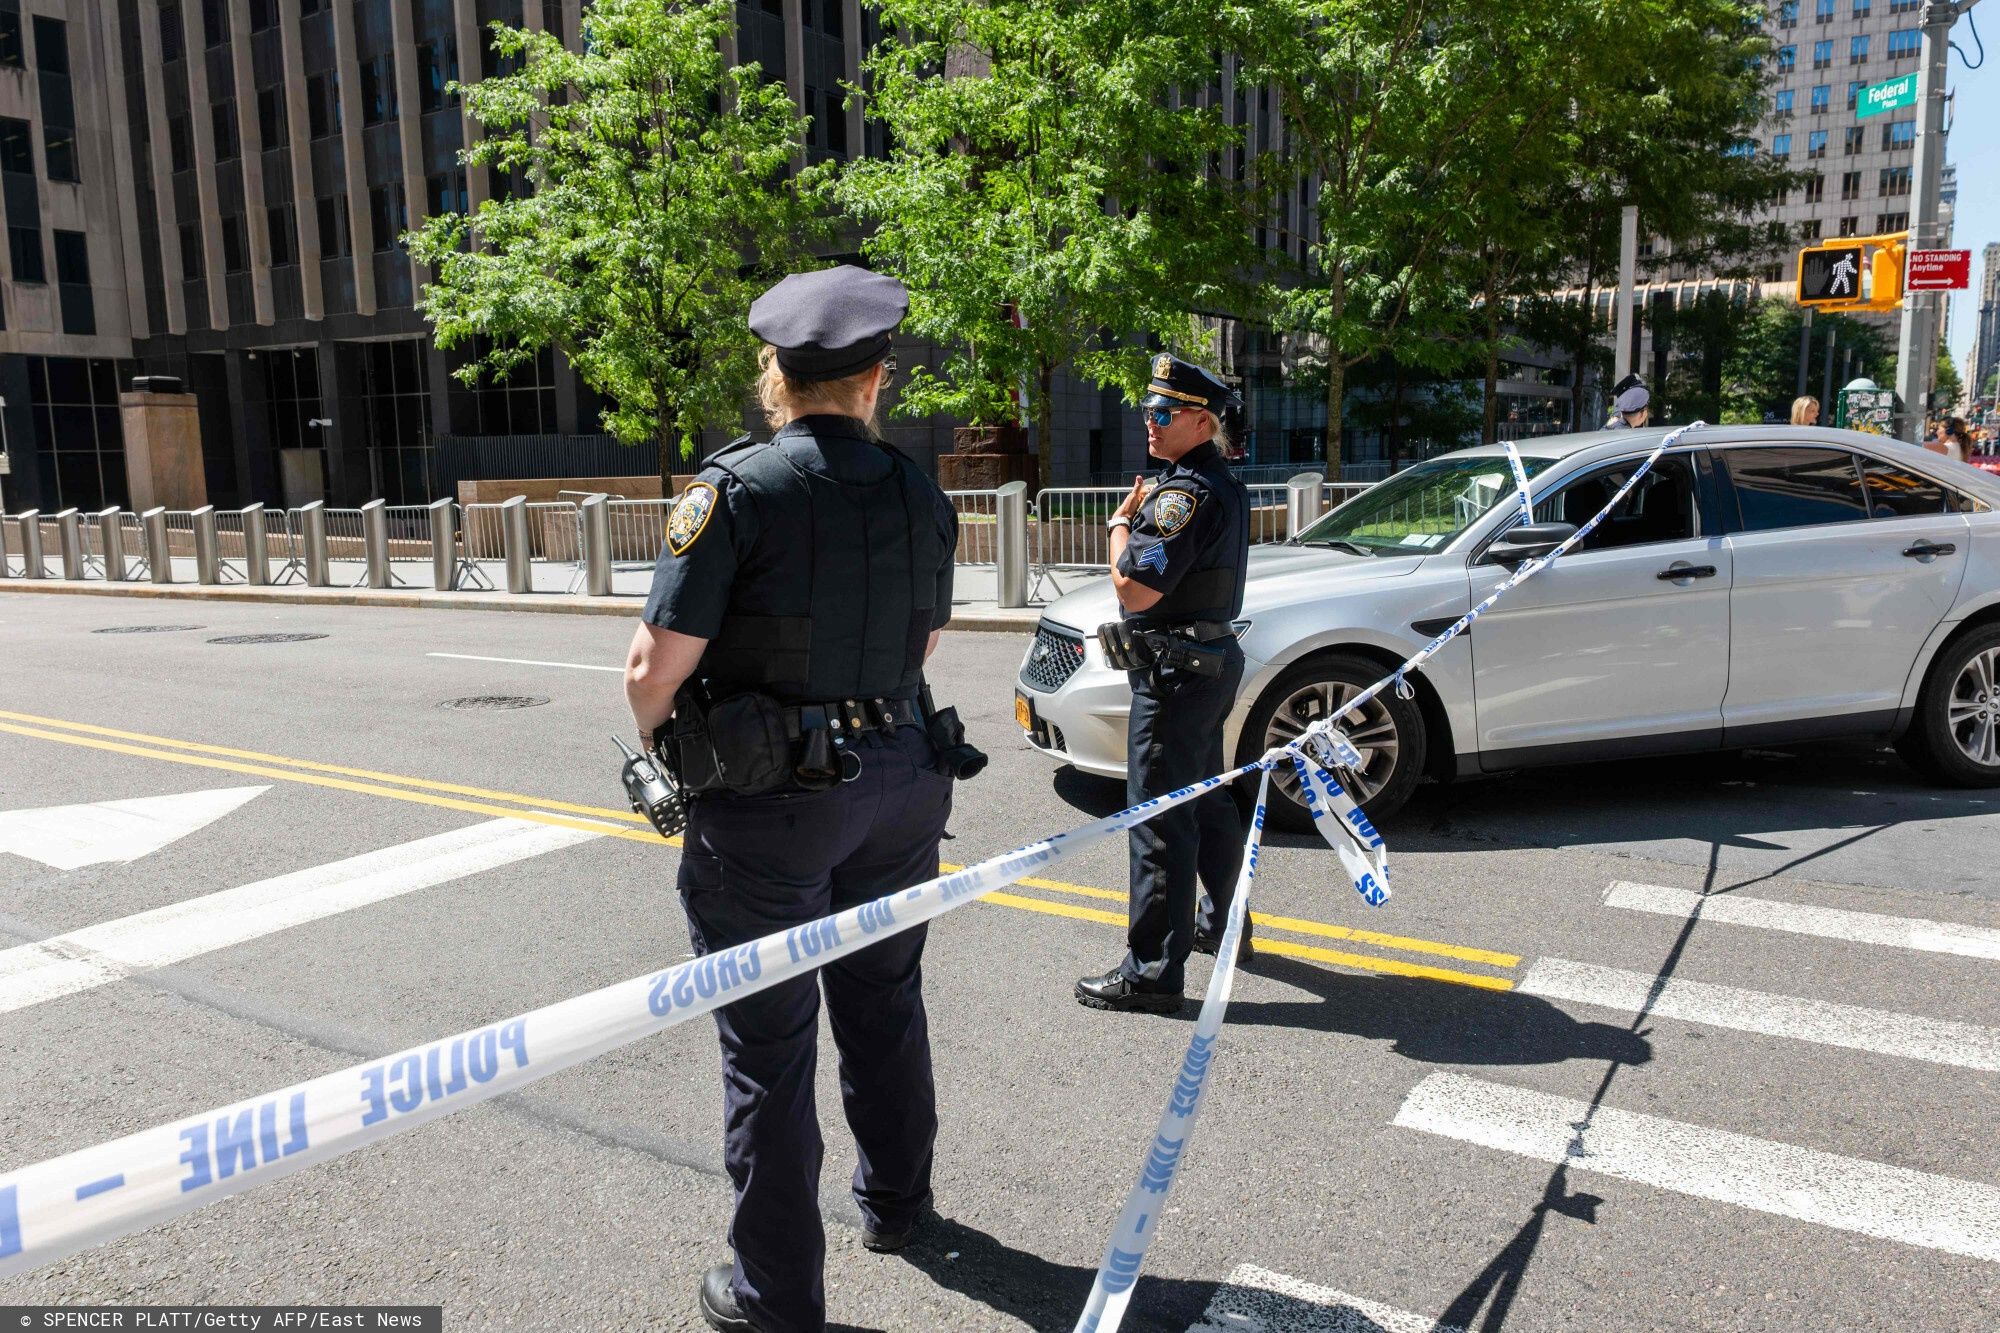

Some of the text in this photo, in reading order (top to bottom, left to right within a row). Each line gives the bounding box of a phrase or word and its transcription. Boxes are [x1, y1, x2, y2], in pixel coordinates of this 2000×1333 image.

[1868, 77, 1909, 104] Federal
[1912, 253, 1962, 262] NO STANDING
[1911, 263, 1944, 273] Anytime
